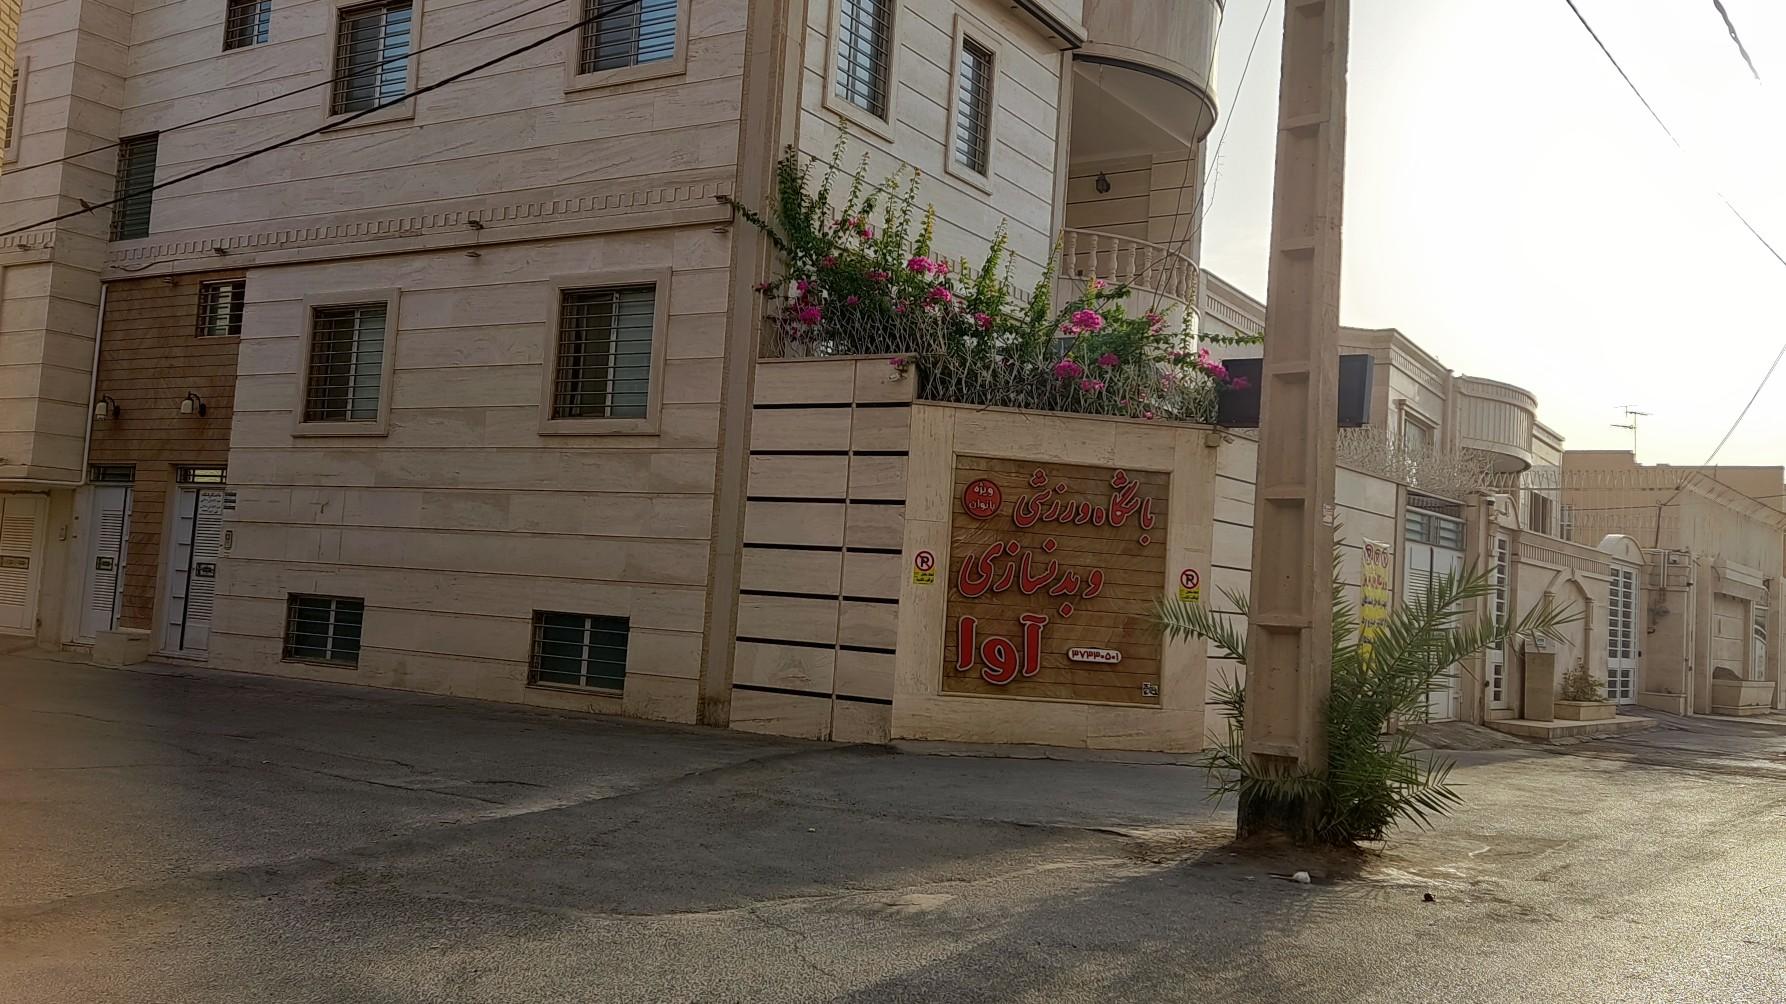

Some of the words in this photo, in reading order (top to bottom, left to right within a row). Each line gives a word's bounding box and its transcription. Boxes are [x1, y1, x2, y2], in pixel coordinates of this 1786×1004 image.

[968, 499, 996, 512] بانوان
[973, 481, 994, 497] ویژه
[1014, 468, 1092, 528] ورزشی
[1093, 469, 1155, 546] باشگاه
[956, 613, 1049, 685] آوا
